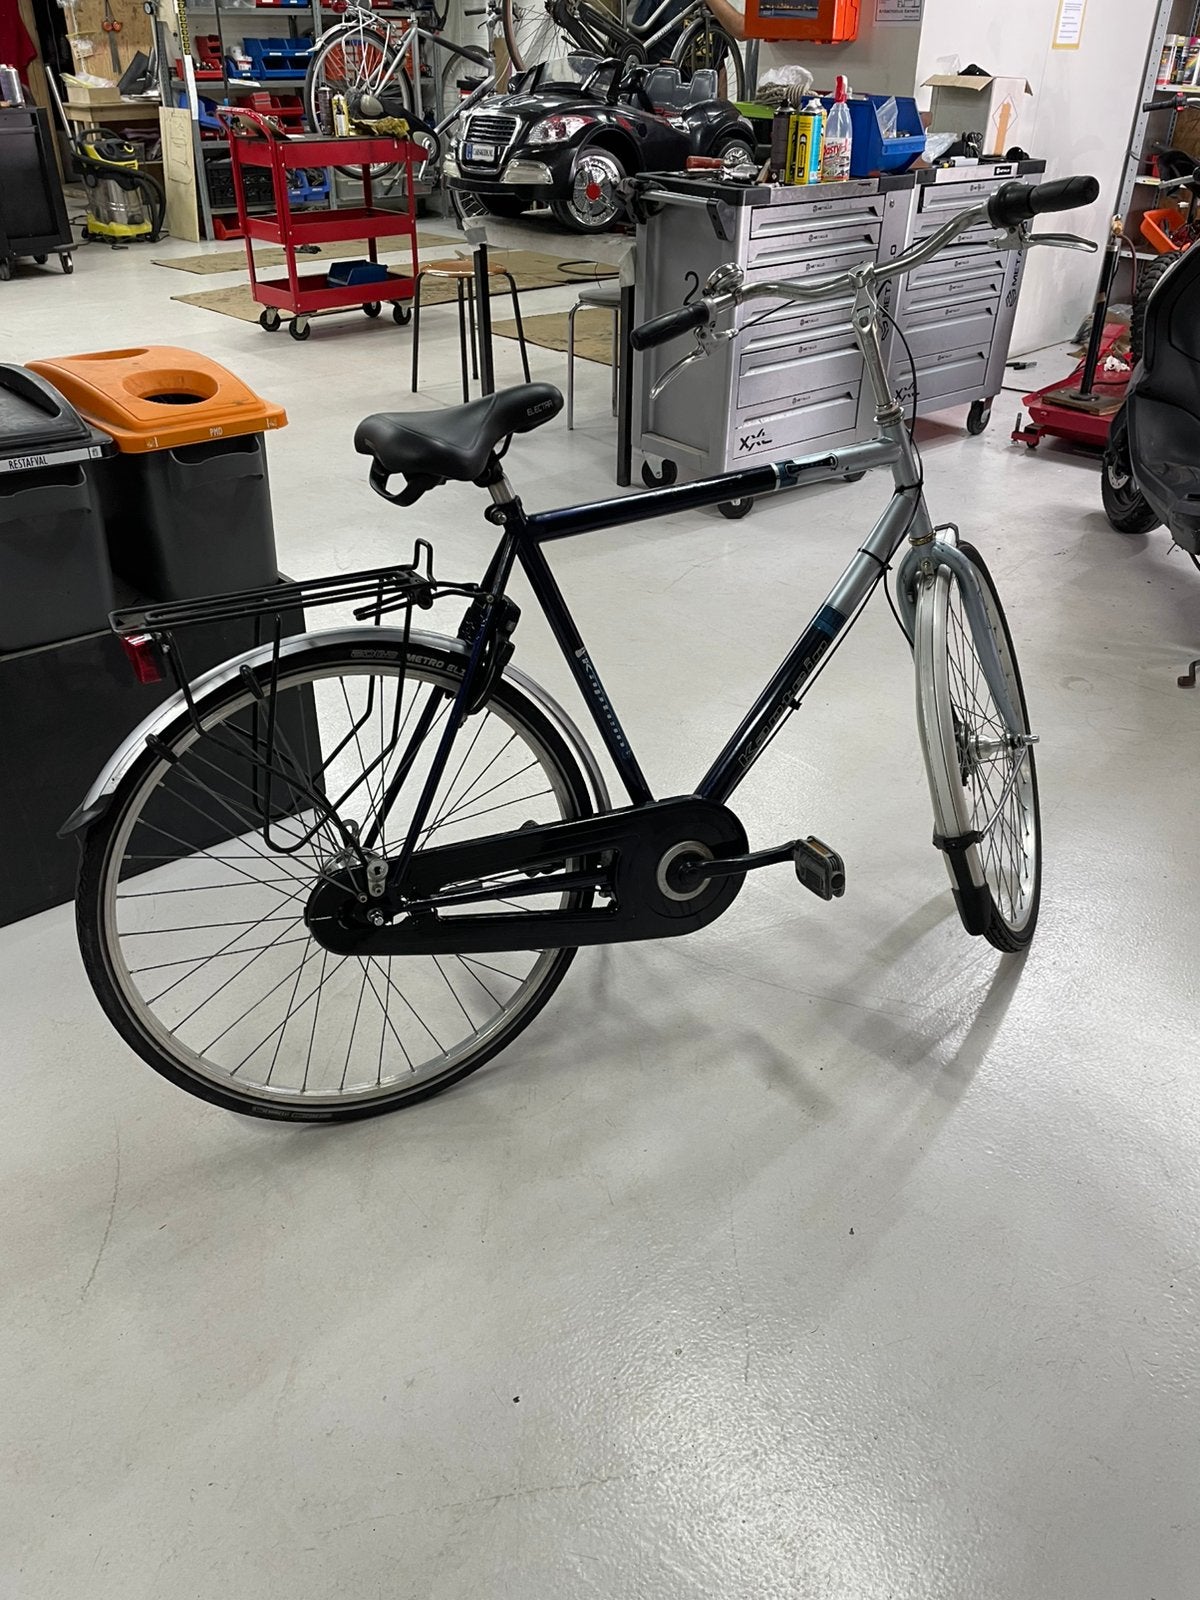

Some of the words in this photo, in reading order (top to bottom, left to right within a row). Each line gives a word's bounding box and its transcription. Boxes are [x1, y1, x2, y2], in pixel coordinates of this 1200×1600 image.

[683, 271, 700, 306] 2
[209, 426, 223, 437] PMD
[8, 455, 49, 470] RESTAFVAL
